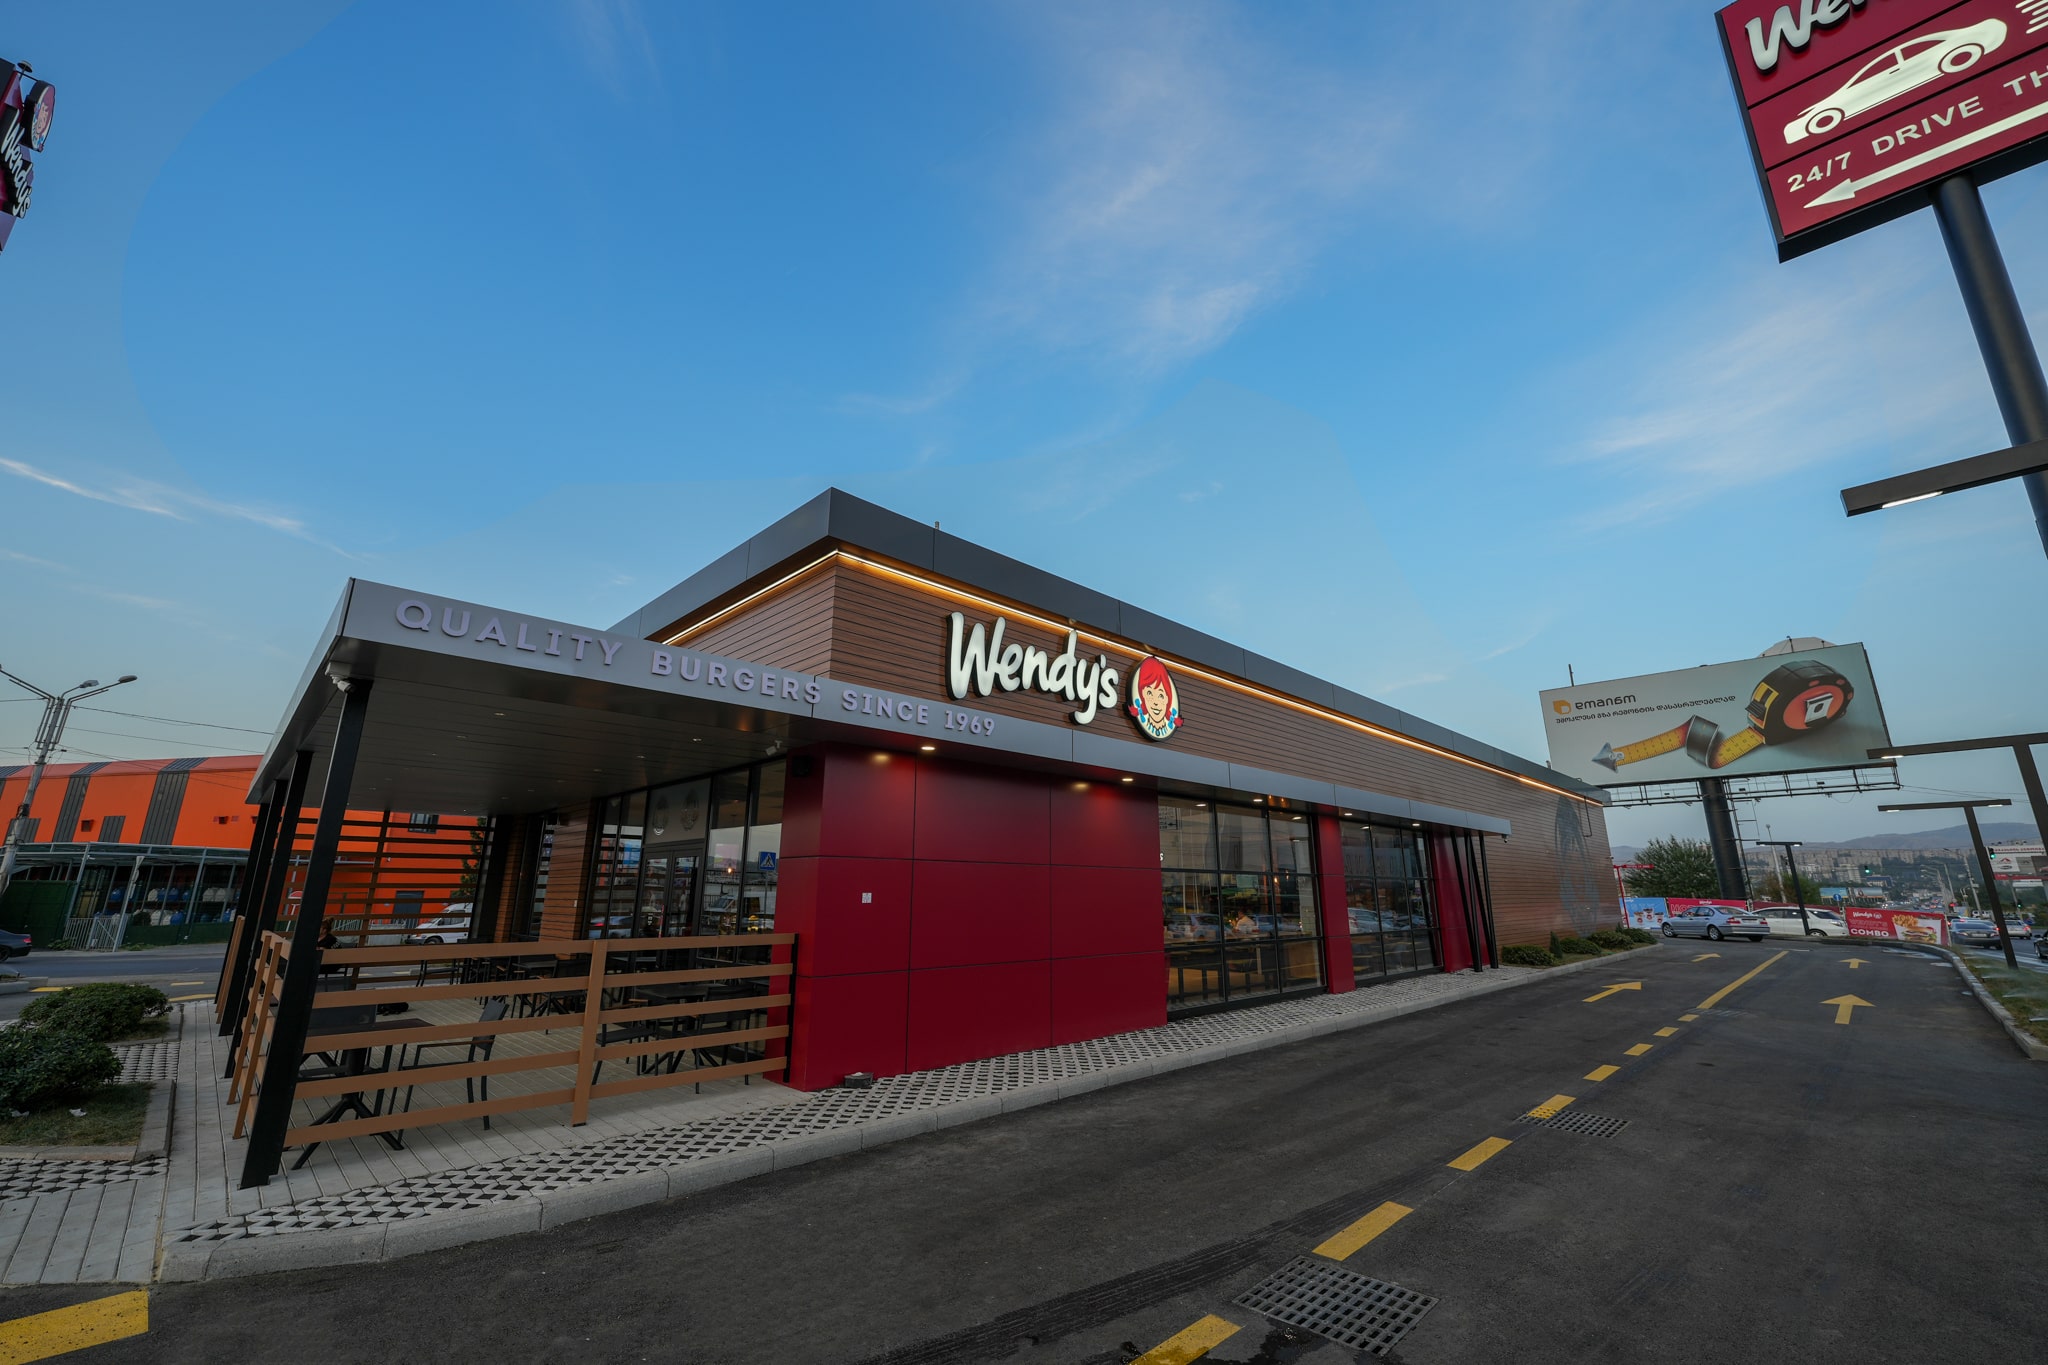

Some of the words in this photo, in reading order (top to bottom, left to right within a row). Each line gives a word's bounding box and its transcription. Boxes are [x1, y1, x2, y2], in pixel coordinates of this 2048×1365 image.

[1745, 0, 1865, 70] We
[1, 108, 33, 218] Wendy's
[1787, 151, 1851, 192] 24/7
[1871, 96, 1984, 156] DRIVE
[395, 599, 625, 666] QUALITY
[651, 649, 823, 704] BURGERS
[841, 689, 930, 726] SINCE
[944, 710, 996, 737] 1969
[948, 611, 1119, 725] Wendy's
[1850, 928, 1889, 937] COMBO
